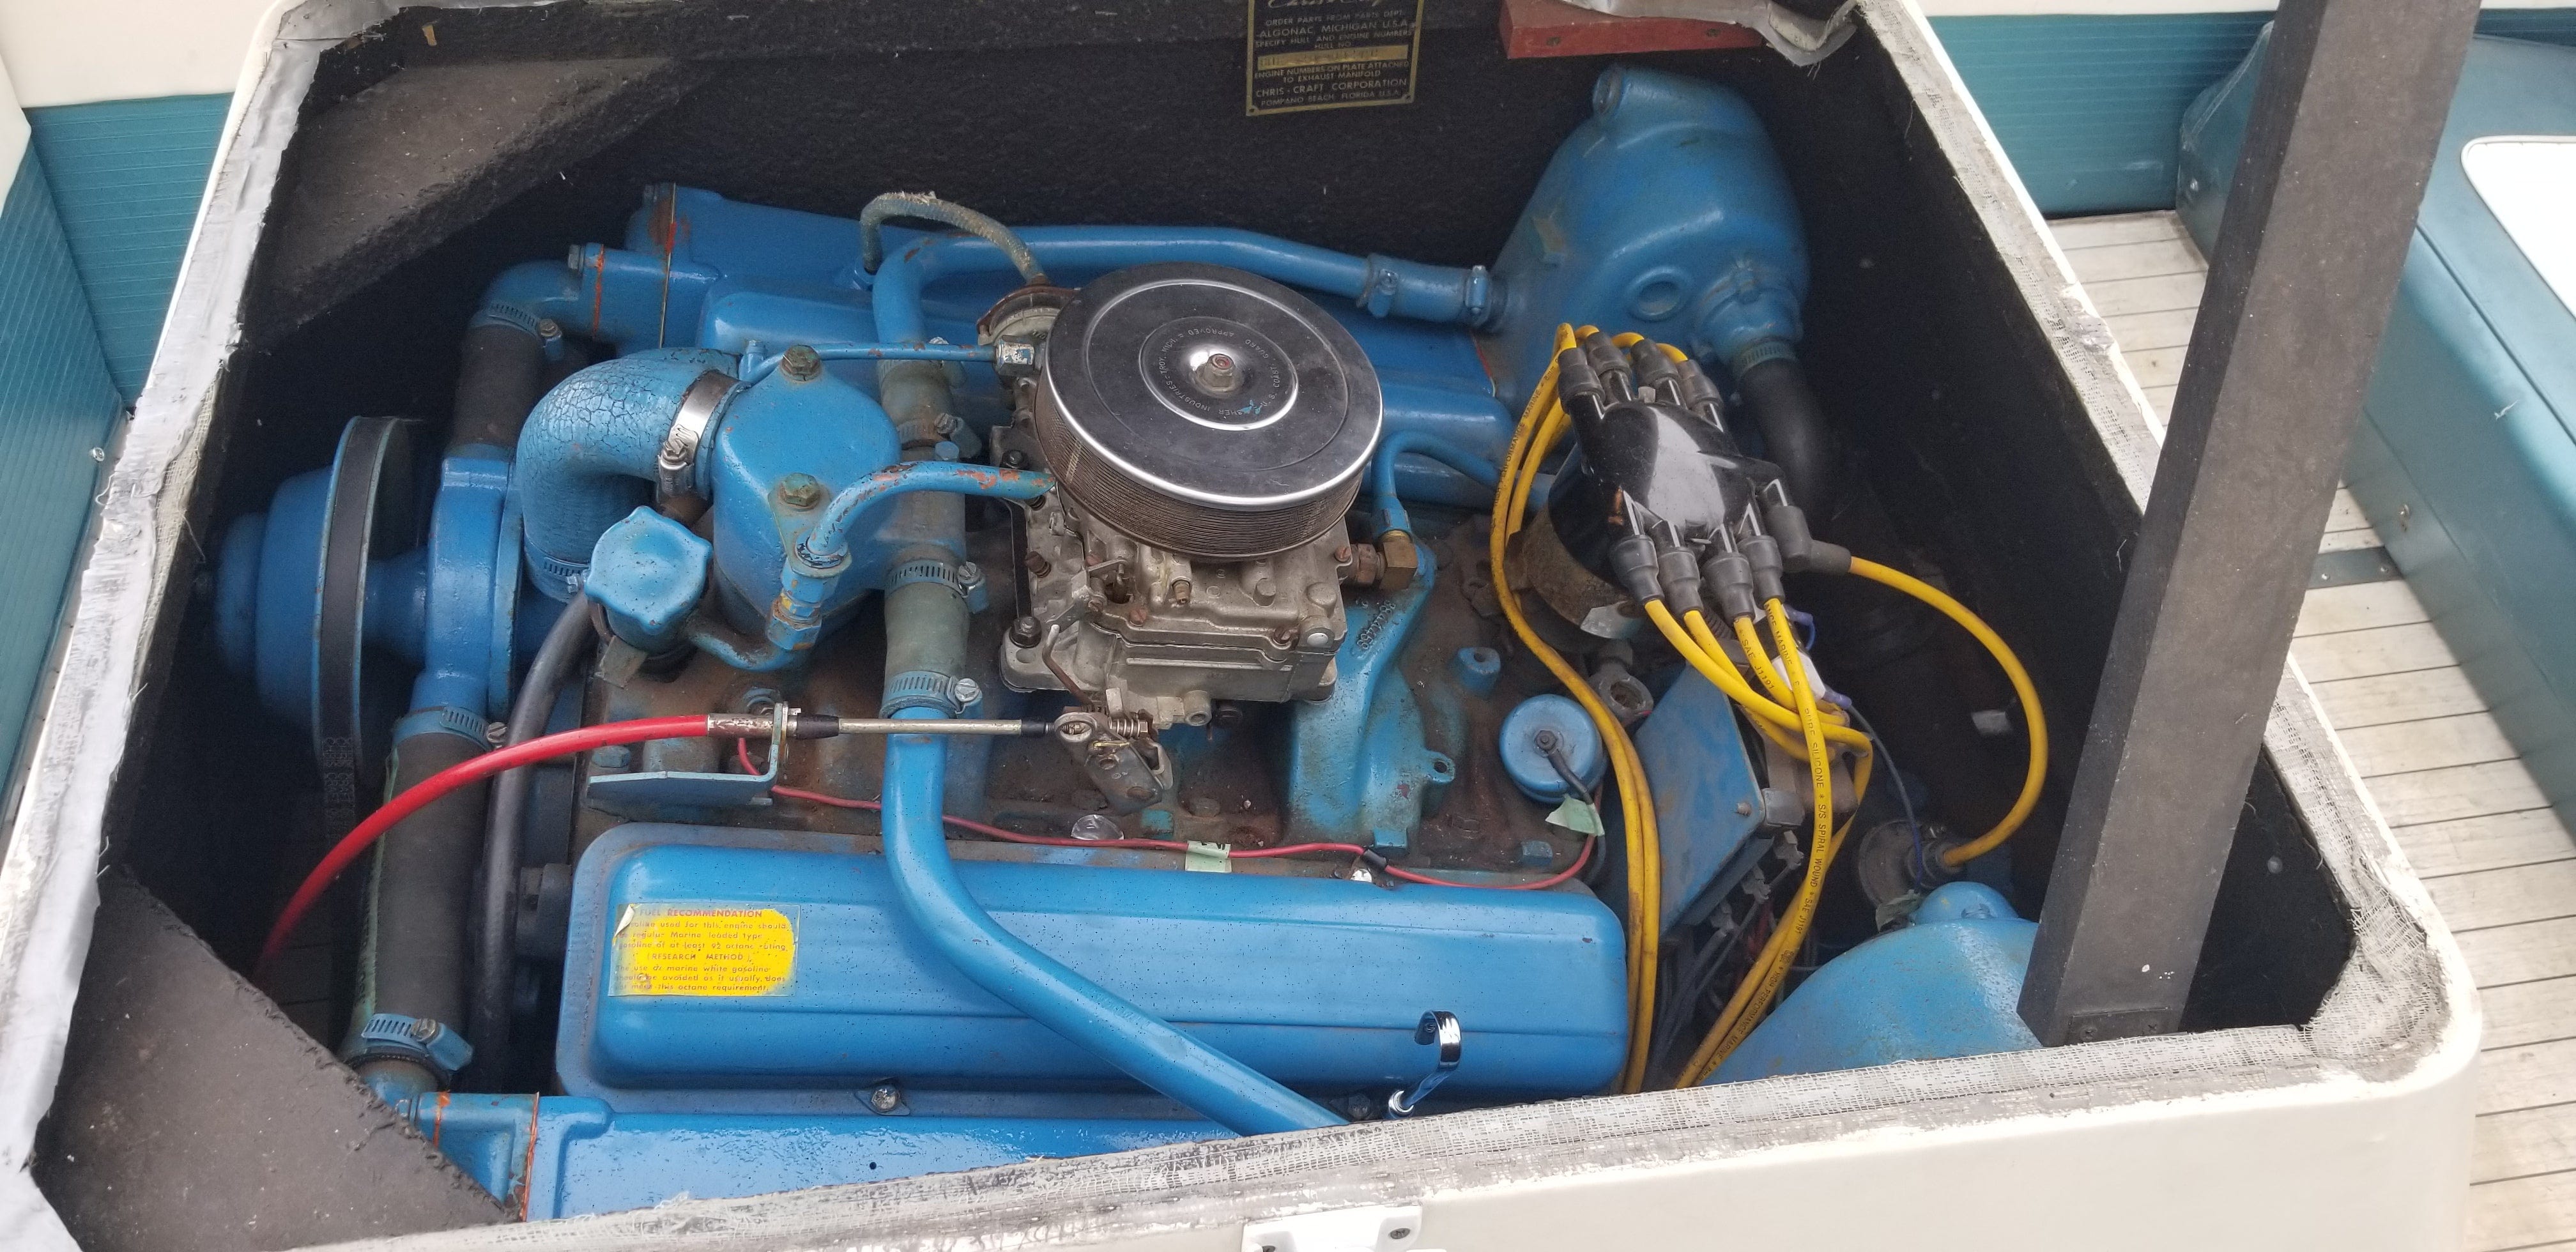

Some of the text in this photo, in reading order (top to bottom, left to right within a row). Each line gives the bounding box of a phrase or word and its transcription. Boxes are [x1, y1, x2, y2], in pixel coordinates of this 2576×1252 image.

[1321, 22, 1377, 33] MICHIGAN
[1255, 70, 1284, 79] ENGINE
[1287, 66, 1324, 75] NUMBERS
[1343, 63, 1365, 71] PLATE
[1298, 73, 1334, 82] EXHAUST
[1338, 70, 1381, 78] MANIFOLD
[1256, 87, 1284, 97] CHRIS
[1293, 83, 1324, 94] CRAFT
[1332, 78, 1406, 90] CORPORATION
[1188, 328, 1234, 337] APPROVED
[1245, 339, 1269, 359] GUARD
[1166, 381, 1211, 412] INDUSTRIES
[1742, 639, 1775, 689] SAE J1191
[1818, 804, 1827, 819] S/S
[1816, 823, 1827, 853] SPIRAL
[1810, 859, 1823, 887] WOUND
[668, 909, 762, 917] RECOMMENDATION
[1802, 898, 1813, 913] SAE
[732, 965, 769, 973] gasoline
